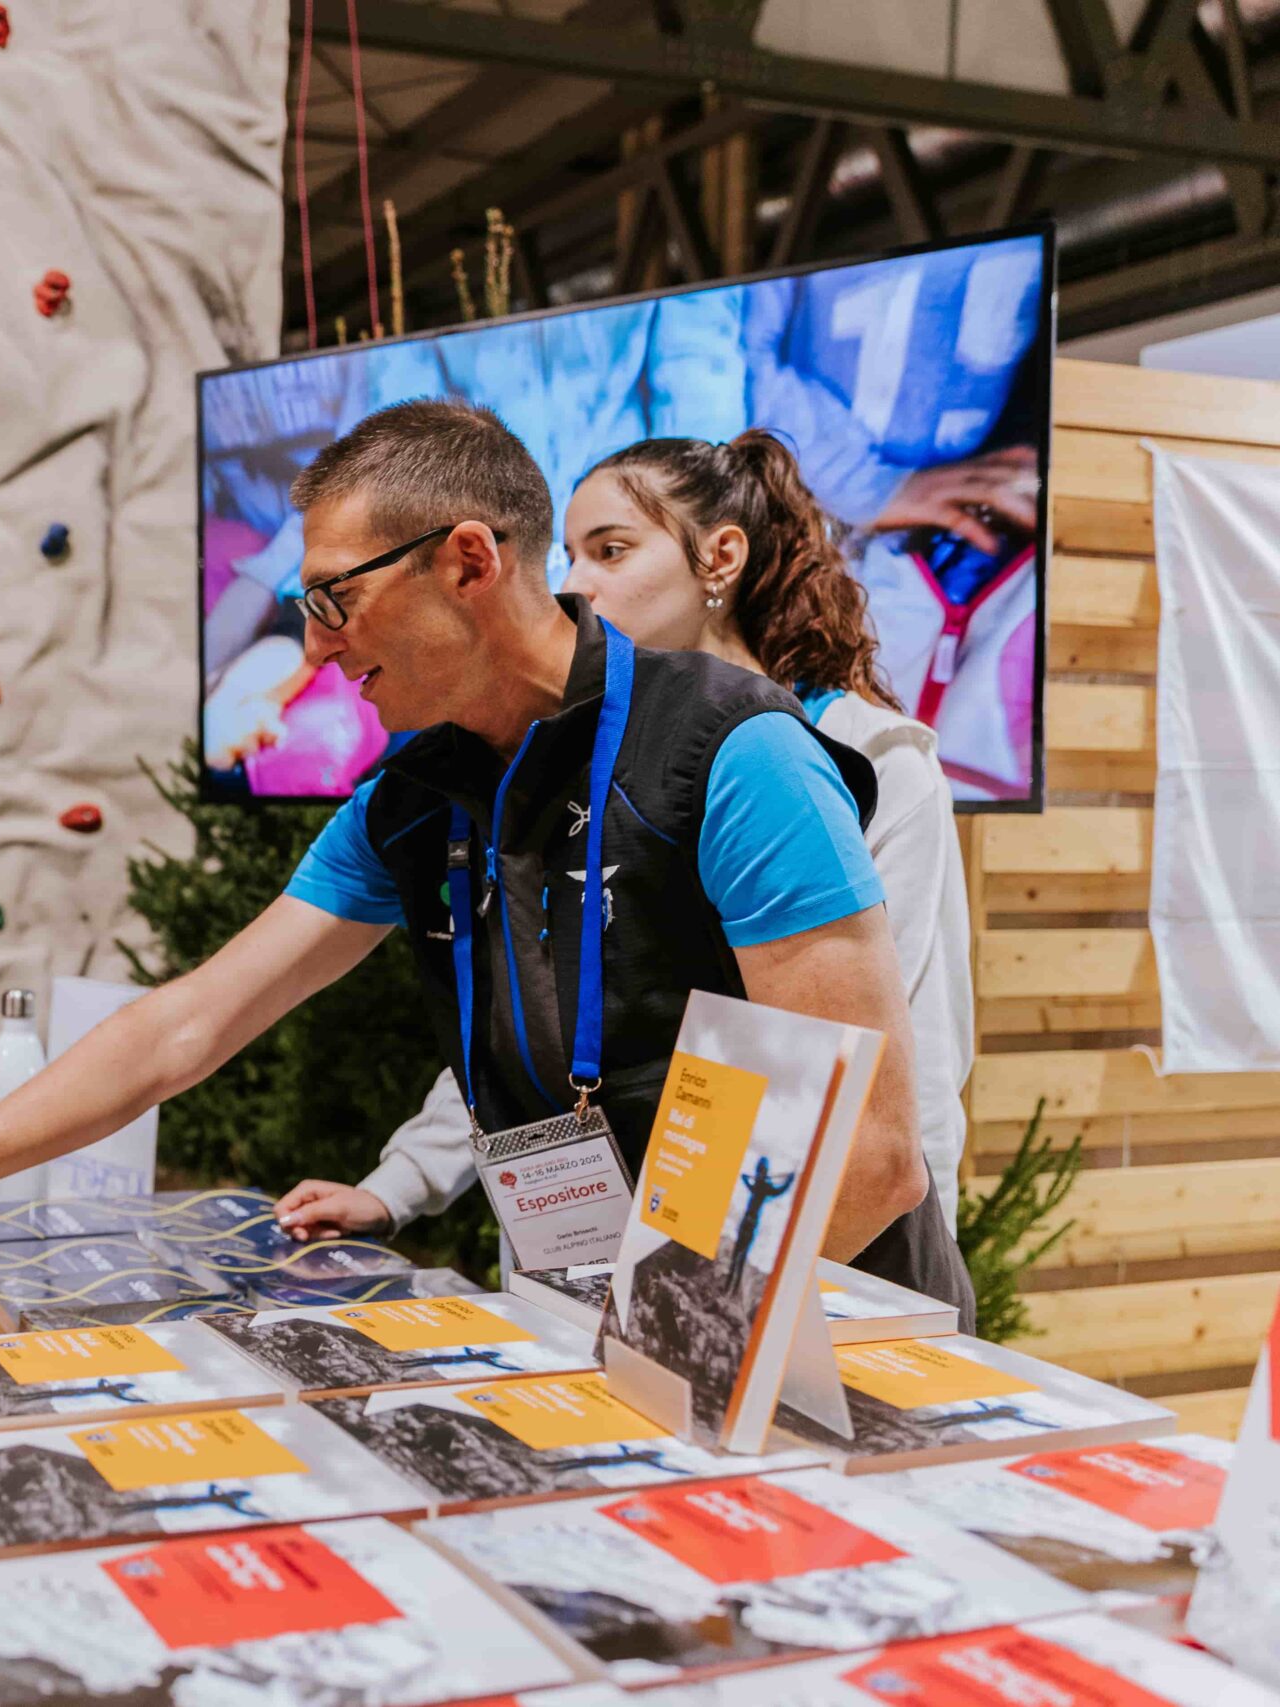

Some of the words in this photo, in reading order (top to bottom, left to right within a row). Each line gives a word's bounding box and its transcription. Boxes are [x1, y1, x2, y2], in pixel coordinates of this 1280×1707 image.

[545, 1160, 579, 1174] MARZO
[579, 1153, 603, 1167] 2025
[516, 1180, 609, 1212] Espositore
[589, 1231, 622, 1245] ITALIANO
